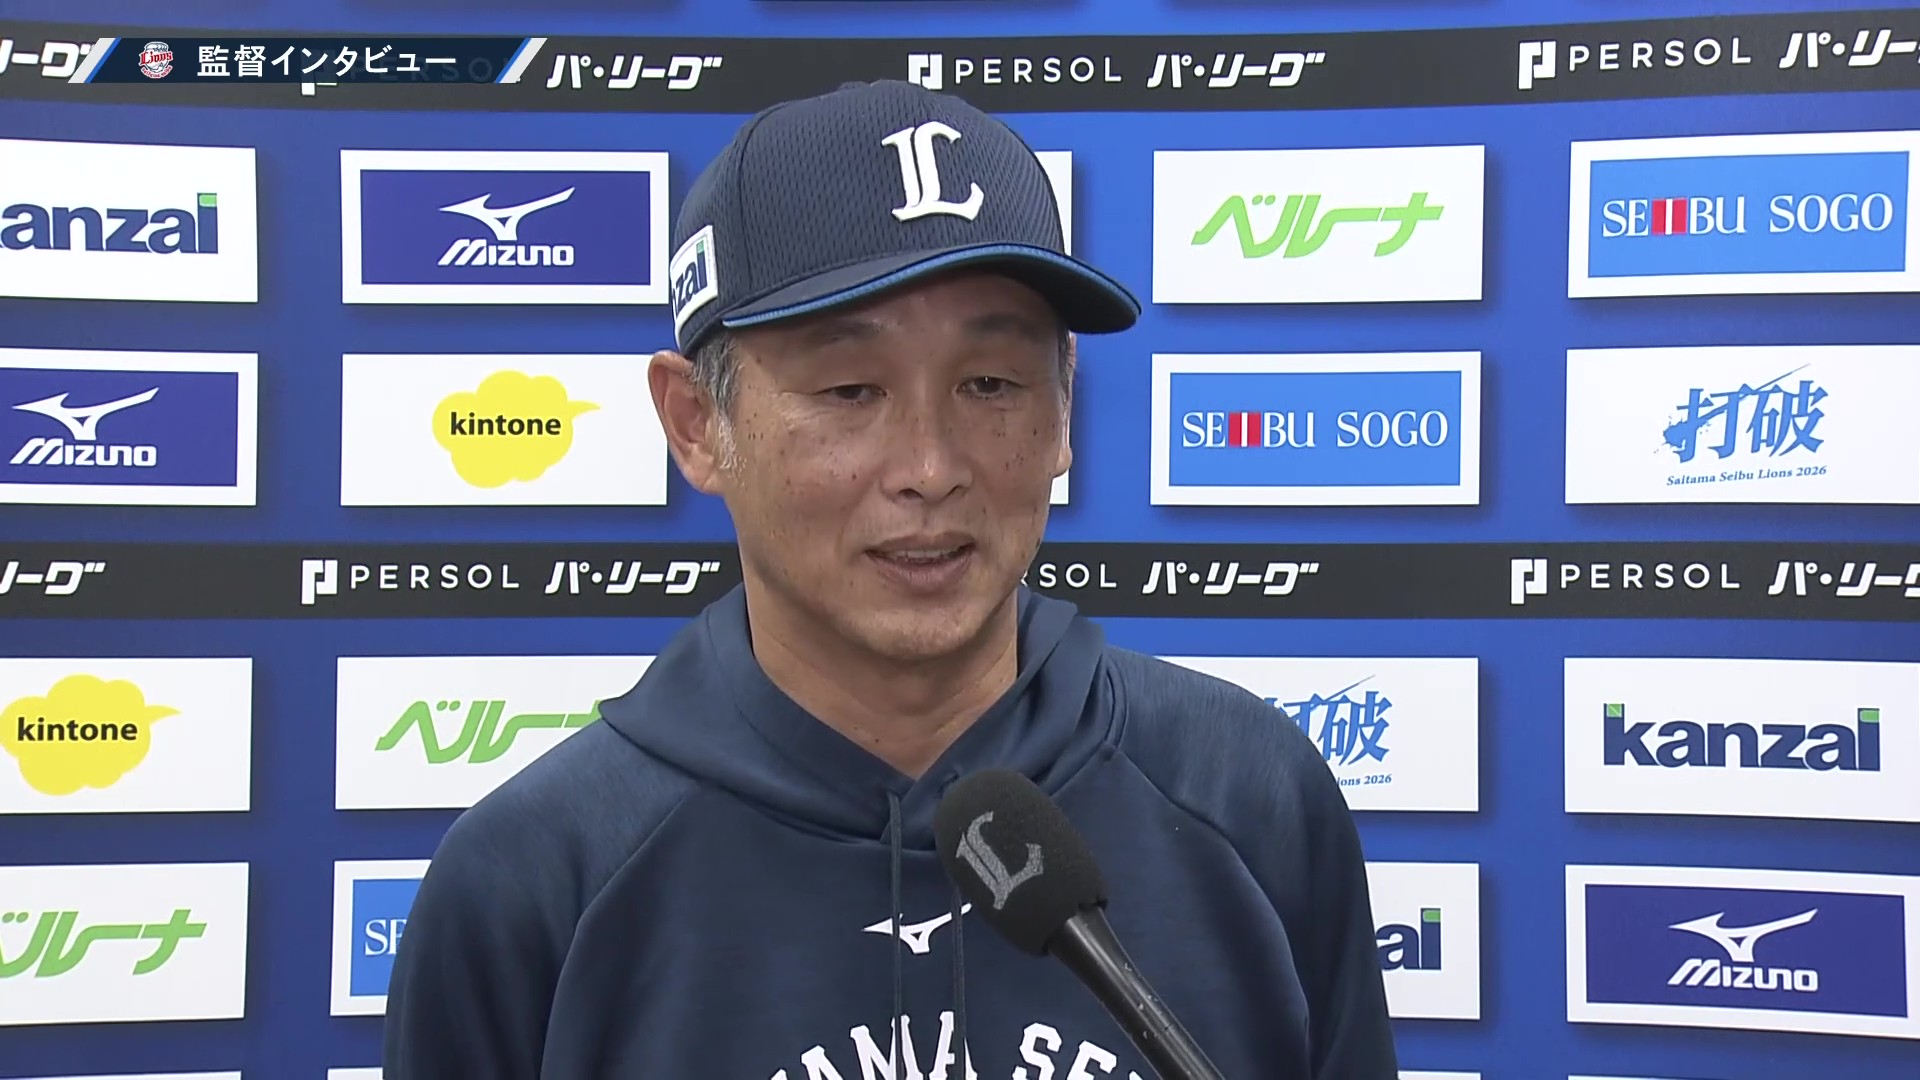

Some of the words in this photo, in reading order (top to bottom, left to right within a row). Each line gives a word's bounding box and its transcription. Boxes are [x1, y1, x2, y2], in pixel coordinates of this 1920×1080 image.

[1570, 37, 1751, 70] PERSOL
[1779, 29, 1920, 68] パ・リー
[546, 54, 722, 90] パ・リーグ
[955, 57, 1121, 83] PERSOL
[1147, 52, 1326, 90] パ・リーグ
[0, 192, 218, 254] anzai
[1190, 192, 1445, 259] ベルーナ
[1768, 193, 1894, 235] SOGO
[449, 411, 562, 437] kintone
[1336, 410, 1449, 448] SOGO
[1656, 376, 1829, 463] 打破
[1666, 475, 1716, 486] Saitama
[1719, 470, 1754, 483] Seibu
[1757, 468, 1793, 480] Lions
[1795, 465, 1827, 477] 2026
[350, 564, 519, 589] PERSOL
[545, 561, 720, 595] パ・リーグ
[1142, 561, 1319, 595] パ・リーグ
[1561, 563, 1739, 589] PERSOL
[17, 717, 138, 742] kintone
[1604, 703, 1880, 771] kanzai
[1336, 777, 1361, 787] ions
[1363, 773, 1392, 785] 2026
